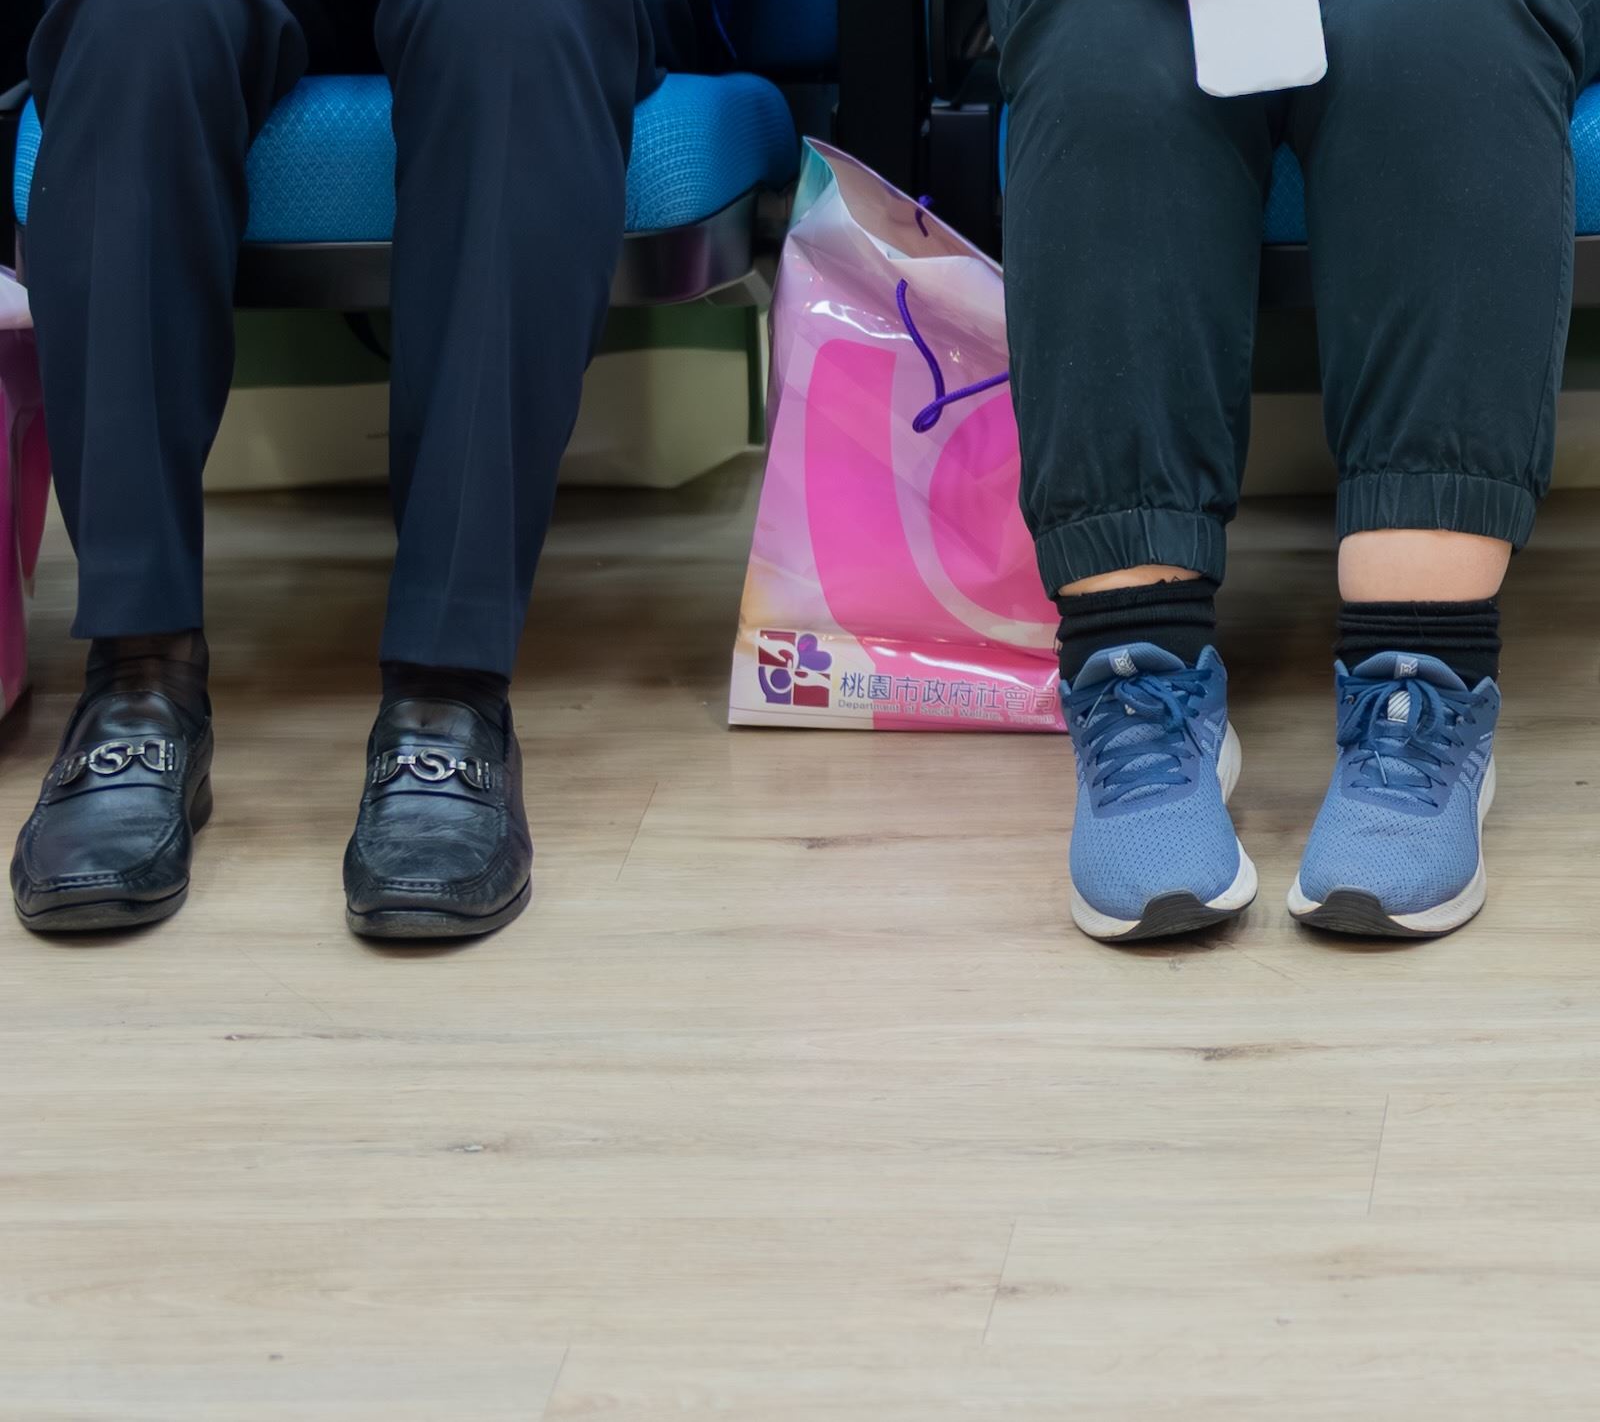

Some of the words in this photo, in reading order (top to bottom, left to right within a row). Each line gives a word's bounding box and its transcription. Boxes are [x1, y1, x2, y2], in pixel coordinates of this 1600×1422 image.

[840, 672, 1056, 713] 桃園市政府社會局
